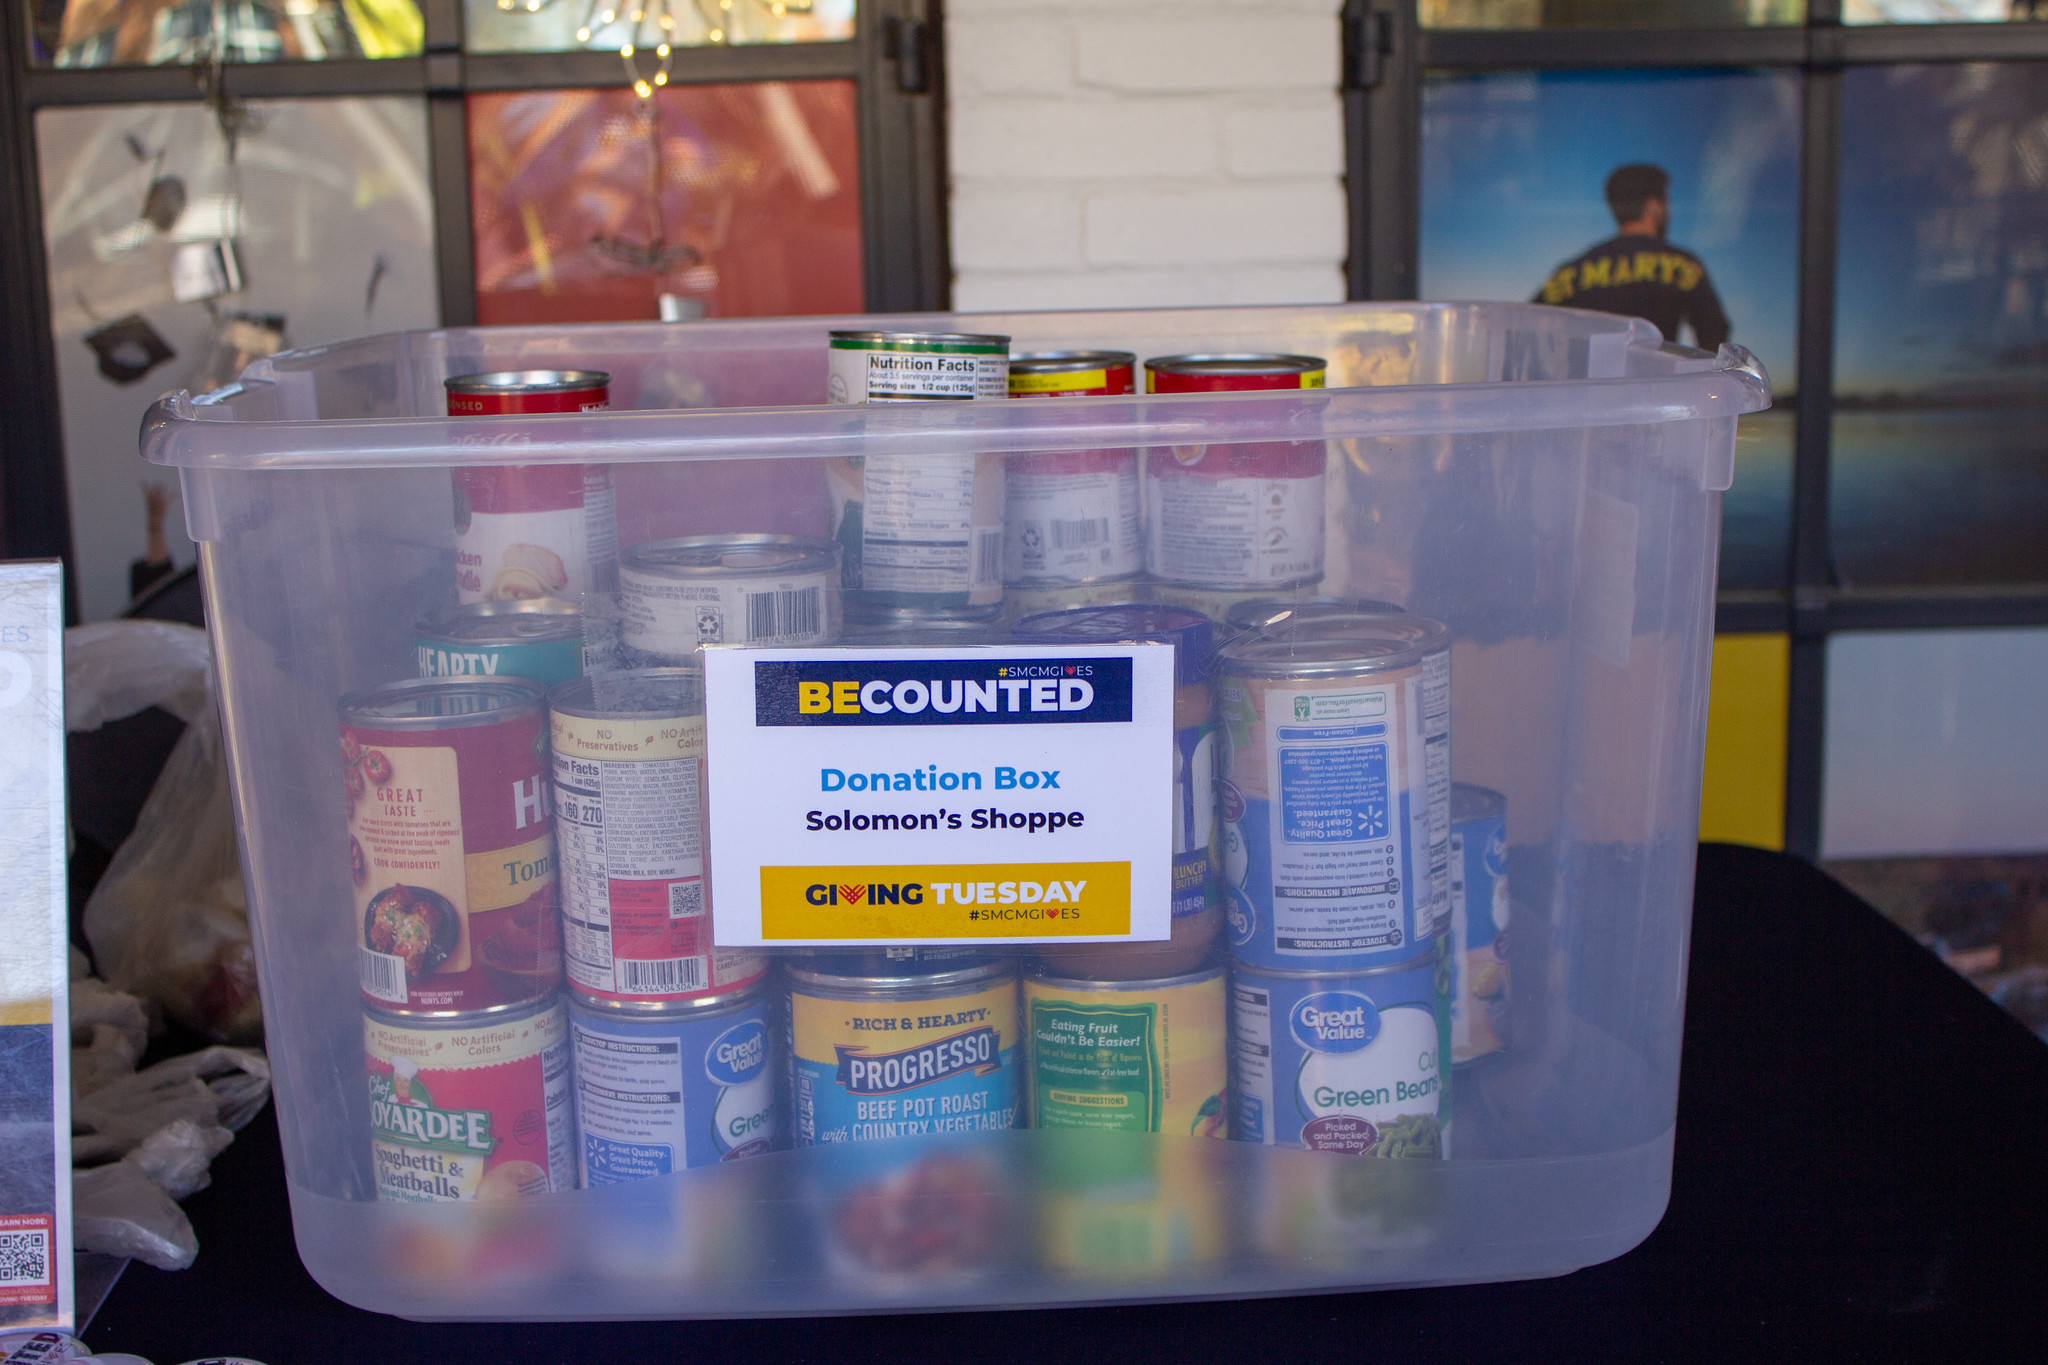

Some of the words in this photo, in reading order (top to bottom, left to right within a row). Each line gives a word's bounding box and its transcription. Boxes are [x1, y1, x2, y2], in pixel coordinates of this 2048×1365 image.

[869, 356, 933, 371] Nutrition
[938, 358, 975, 372] Facts
[869, 371, 888, 380] About
[902, 374, 931, 382] servings
[932, 375, 944, 383] per
[945, 374, 974, 382] container
[869, 381, 898, 391] Serving
[899, 382, 916, 391] size
[922, 383, 934, 392] 1/2
[935, 385, 951, 393] cup
[596, 729, 612, 740] NO
[660, 728, 677, 740] NO
[576, 738, 639, 751] Preservatives
[571, 760, 600, 776] Facts
[820, 765, 982, 792] Donation
[994, 766, 1061, 790] Box
[377, 788, 423, 803] GREAT
[384, 805, 416, 818] TASTE
[564, 801, 579, 820] 160
[582, 804, 602, 823] 270
[1293, 809, 1352, 819] Guaranteed.
[806, 808, 962, 832] Solomon's
[970, 808, 1085, 833] Shoppe
[1298, 820, 1324, 828] Price.
[1326, 818, 1353, 827] Great
[1288, 829, 1325, 839] Quality.
[1326, 829, 1352, 838] Great
[374, 857, 390, 868] COOK
[391, 860, 441, 870] CONFIDENTLY!
[930, 880, 1087, 905] TUESDAY
[1294, 940, 1350, 948] INSTRUCTIONS:
[1352, 936, 1387, 946] STOVETOP
[852, 1017, 897, 1031] RICH
[900, 1017, 913, 1031] &
[917, 1008, 987, 1029] HEARTY
[1301, 1006, 1364, 1028] Great
[1051, 1018, 1086, 1035] Eating
[1089, 1023, 1118, 1035] Fruit
[1317, 1025, 1365, 1040] Value
[389, 1033, 427, 1046] Artificial
[452, 1036, 468, 1047] NO
[470, 1029, 516, 1046] Artificial
[1036, 1029, 1076, 1046] Couldn't
[1079, 1035, 1095, 1047] Be
[1098, 1035, 1140, 1048] Easier!
[468, 1044, 502, 1056] Colors
[607, 1042, 660, 1053] INSTRUCTIONS:
[716, 1031, 762, 1065] Great
[729, 1051, 763, 1074] Value
[851, 1032, 990, 1090] PROGRESSO
[368, 1074, 391, 1100] Chef
[617, 1091, 671, 1103] INSTRUCTIONS:
[1079, 1095, 1125, 1106] SUGGESTIONS
[1314, 1086, 1390, 1108] Green
[857, 1100, 897, 1121] BEEF
[903, 1097, 936, 1118] POT
[941, 1091, 989, 1115] ROAST
[821, 1125, 849, 1143] with
[1325, 1122, 1356, 1132] Picked
[1313, 1132, 1333, 1140] and
[1334, 1131, 1368, 1141] Packed
[609, 1143, 631, 1156] Great
[631, 1147, 668, 1160] Quality.
[1317, 1140, 1344, 1149] Same
[1346, 1140, 1365, 1150] Day
[375, 1143, 444, 1174] Spaghetti
[447, 1161, 464, 1178] &
[609, 1152, 632, 1165] Great
[632, 1157, 657, 1168] Price.
[379, 1165, 460, 1199] Meatballs
[22, 1217, 48, 1226] MORE:
